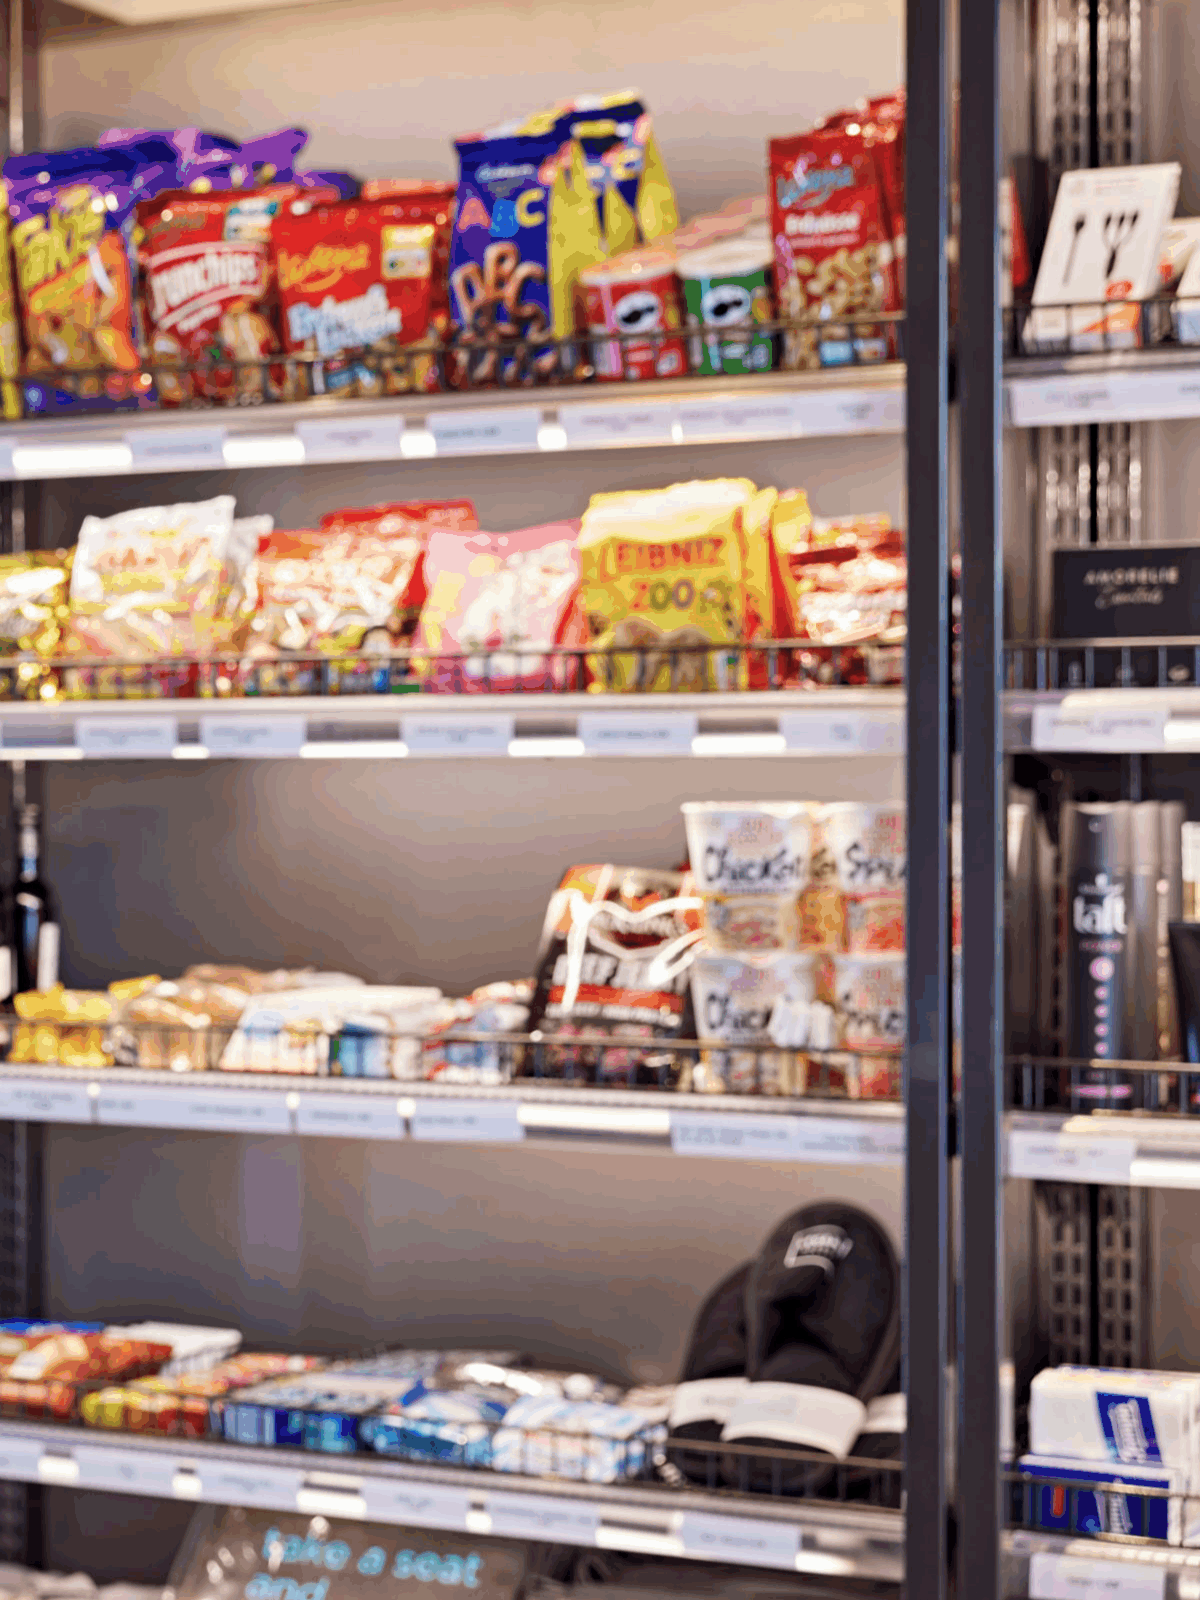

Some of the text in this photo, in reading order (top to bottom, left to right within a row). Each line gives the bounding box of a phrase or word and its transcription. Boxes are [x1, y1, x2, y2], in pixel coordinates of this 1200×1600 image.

[630, 579, 696, 613] ZOO
[263, 1526, 481, 1588] take a seat
